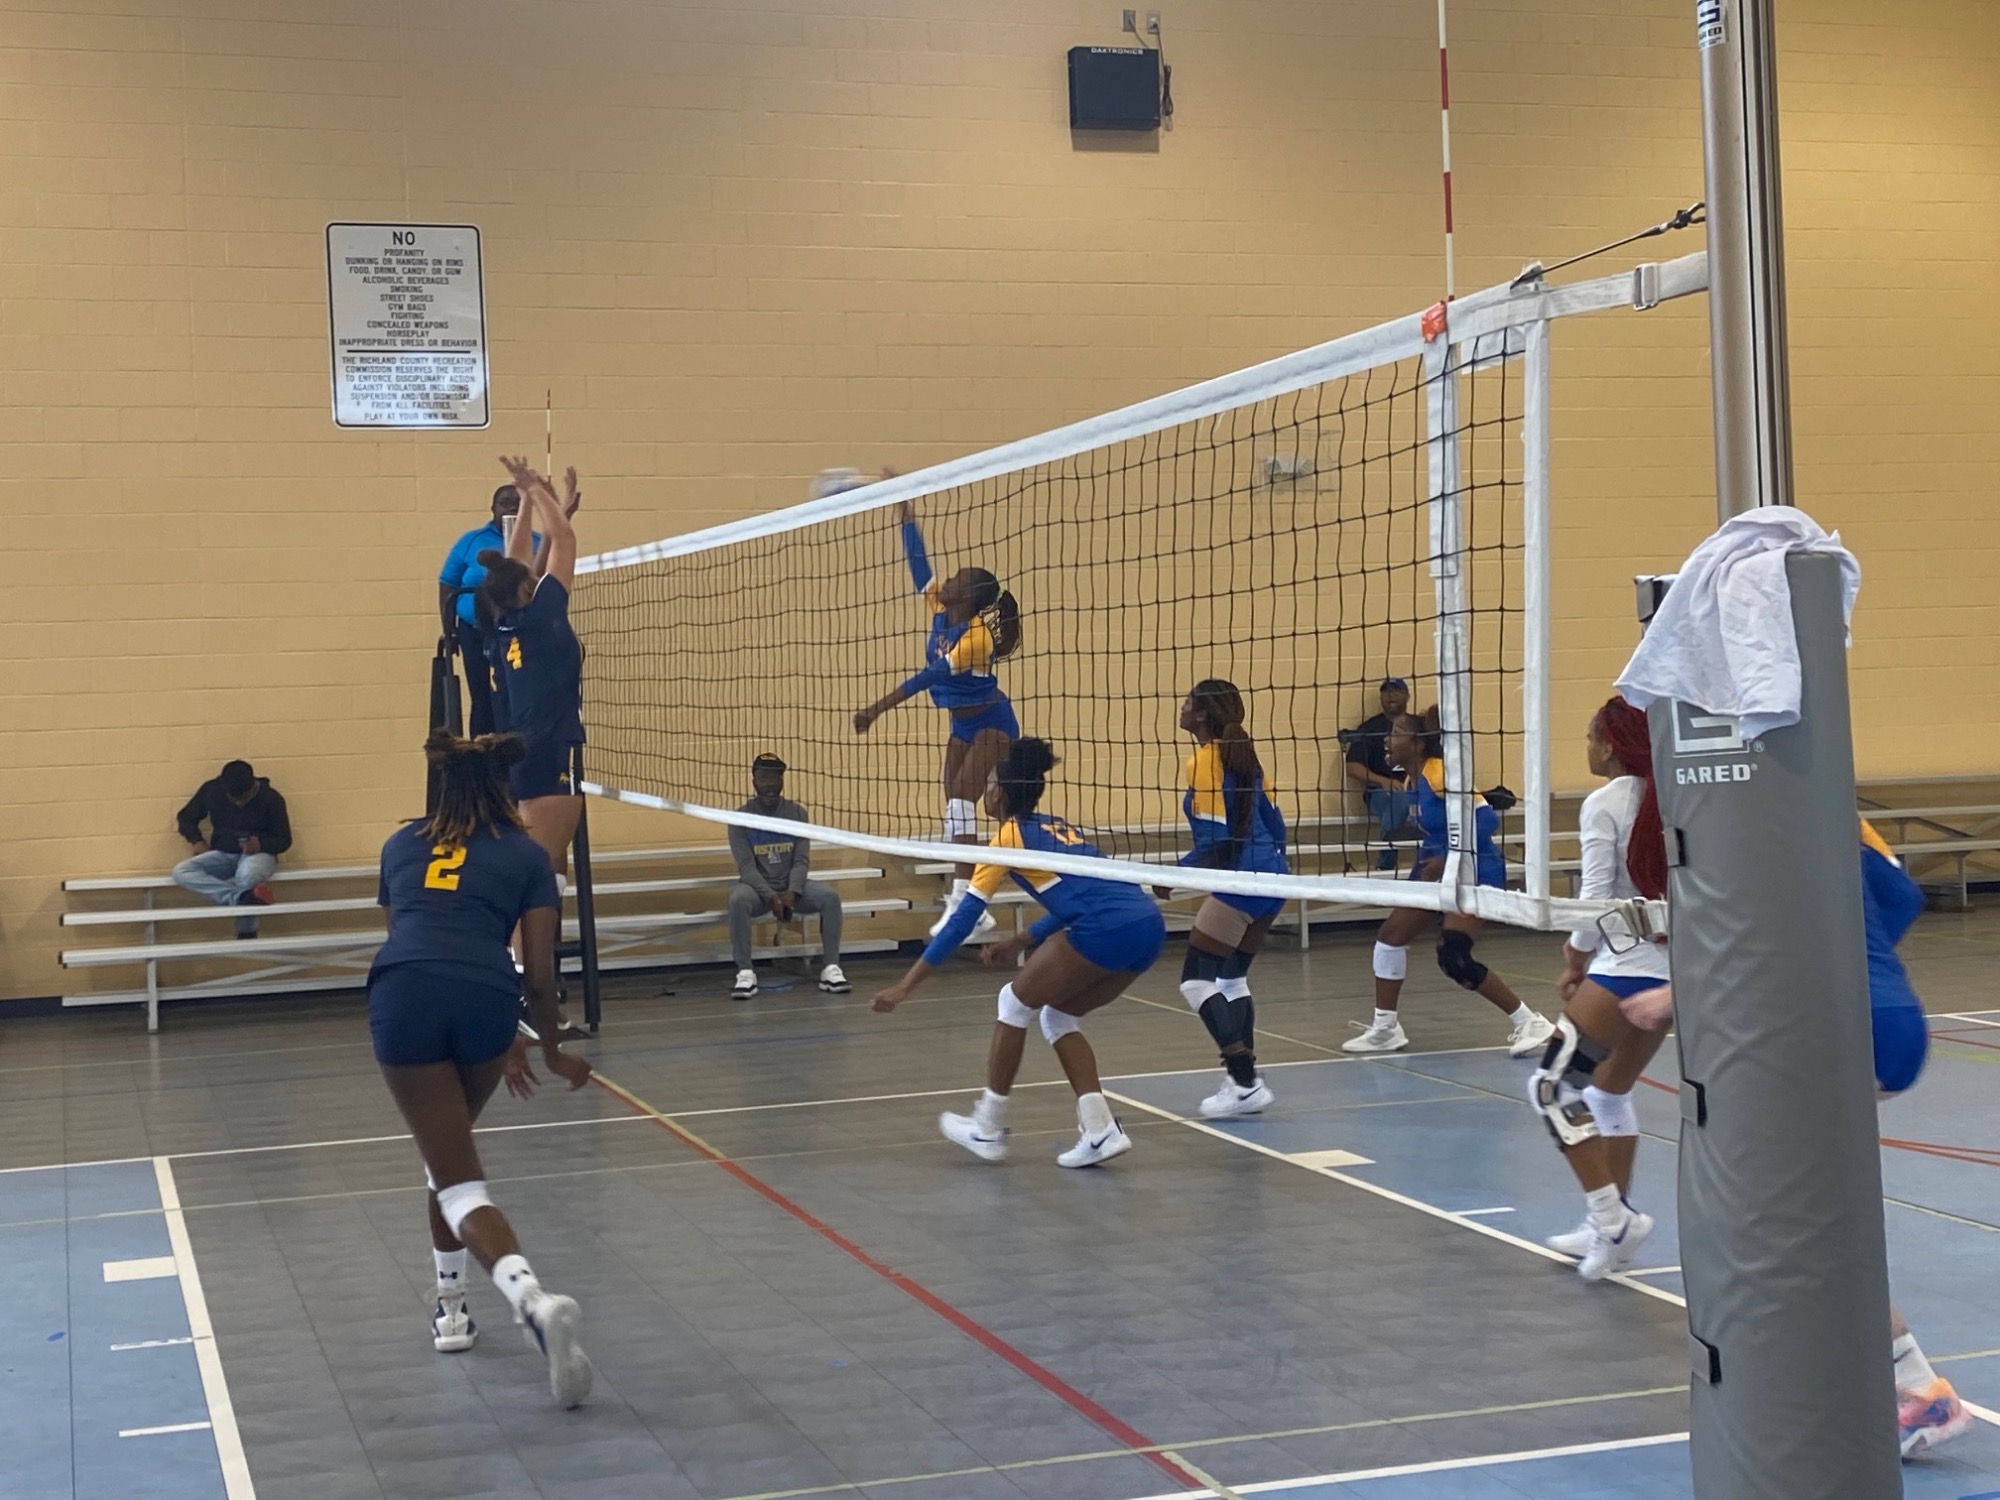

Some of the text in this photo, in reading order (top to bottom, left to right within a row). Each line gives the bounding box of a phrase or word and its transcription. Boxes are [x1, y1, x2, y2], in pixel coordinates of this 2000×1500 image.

[1091, 47, 1144, 55] DAKTRONICS
[393, 231, 415, 245] NO
[345, 257, 378, 265] DUNKING
[380, 294, 406, 302] STREET
[506, 636, 523, 670] 4
[424, 844, 467, 892] 2
